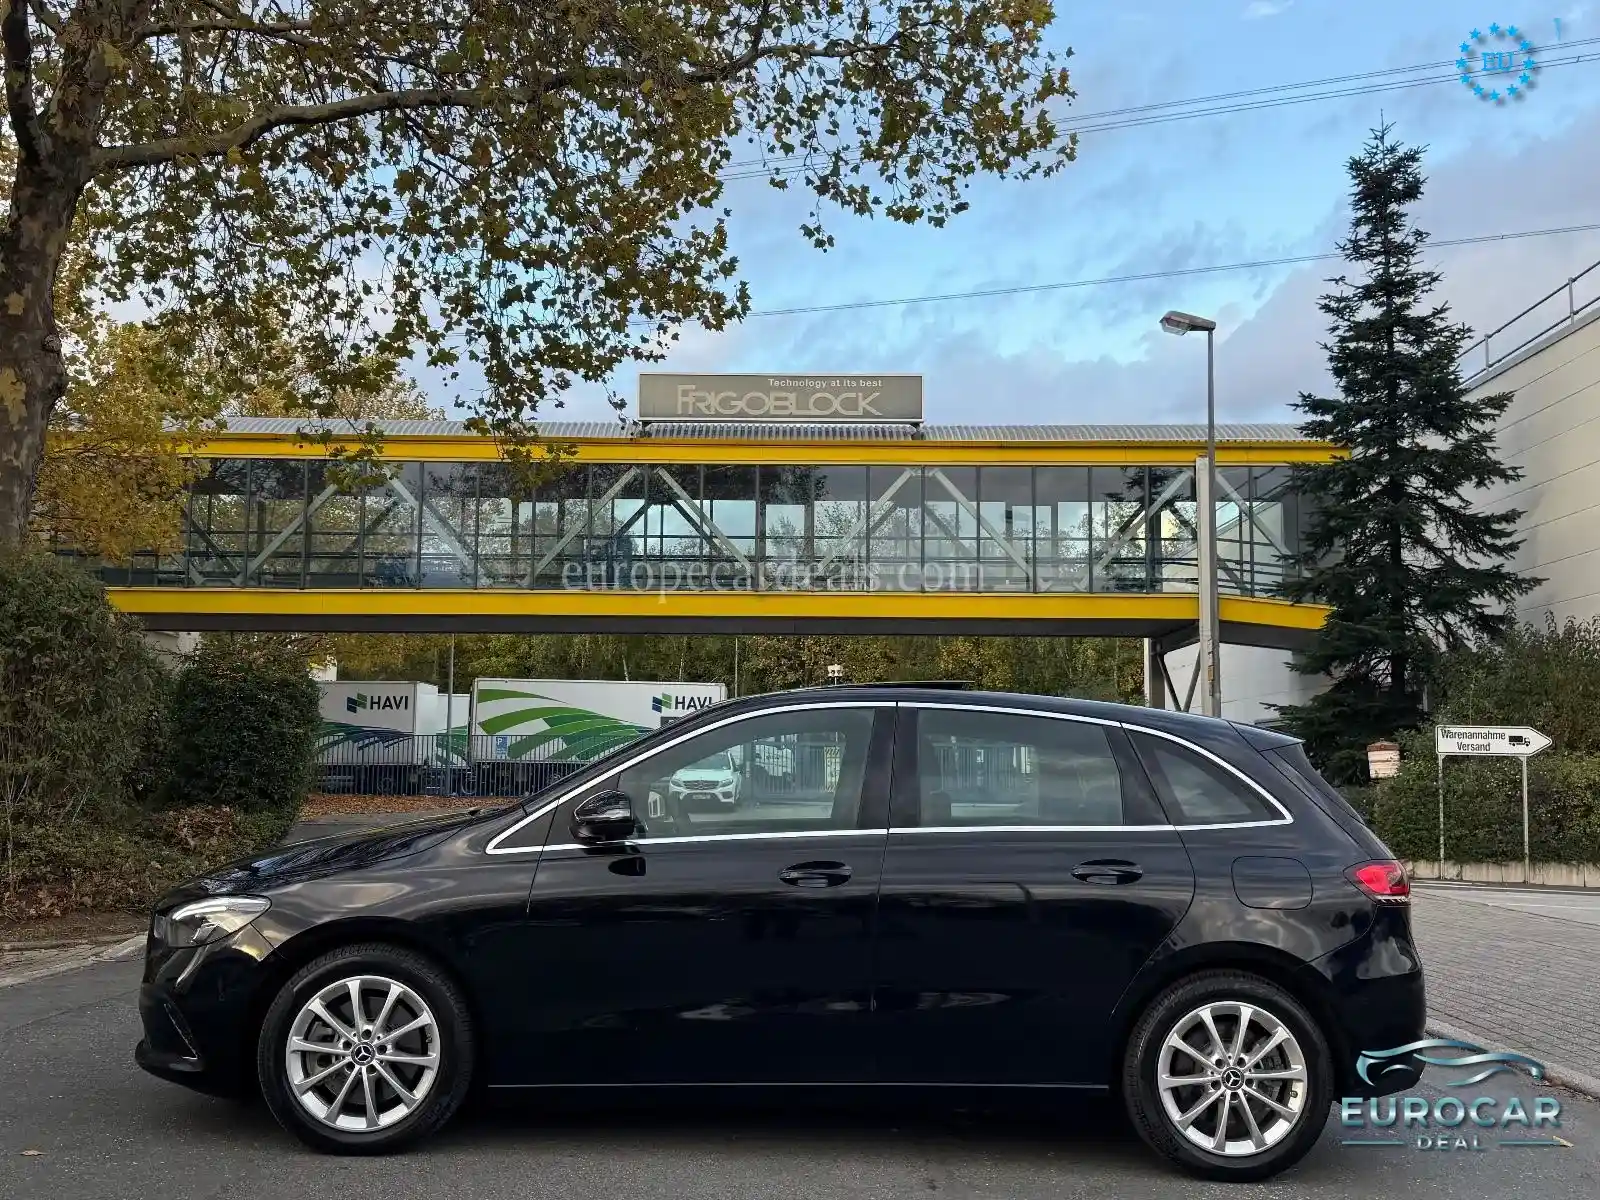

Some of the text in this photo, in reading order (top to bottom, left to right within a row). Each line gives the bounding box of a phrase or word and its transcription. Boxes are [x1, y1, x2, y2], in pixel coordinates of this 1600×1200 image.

[768, 378, 882, 388] Technology at its best
[676, 385, 883, 416] FRIGOBLOCK
[369, 695, 409, 710] HAVI
[1440, 728, 1506, 740] Warenannahme
[1457, 741, 1491, 752] Versand
